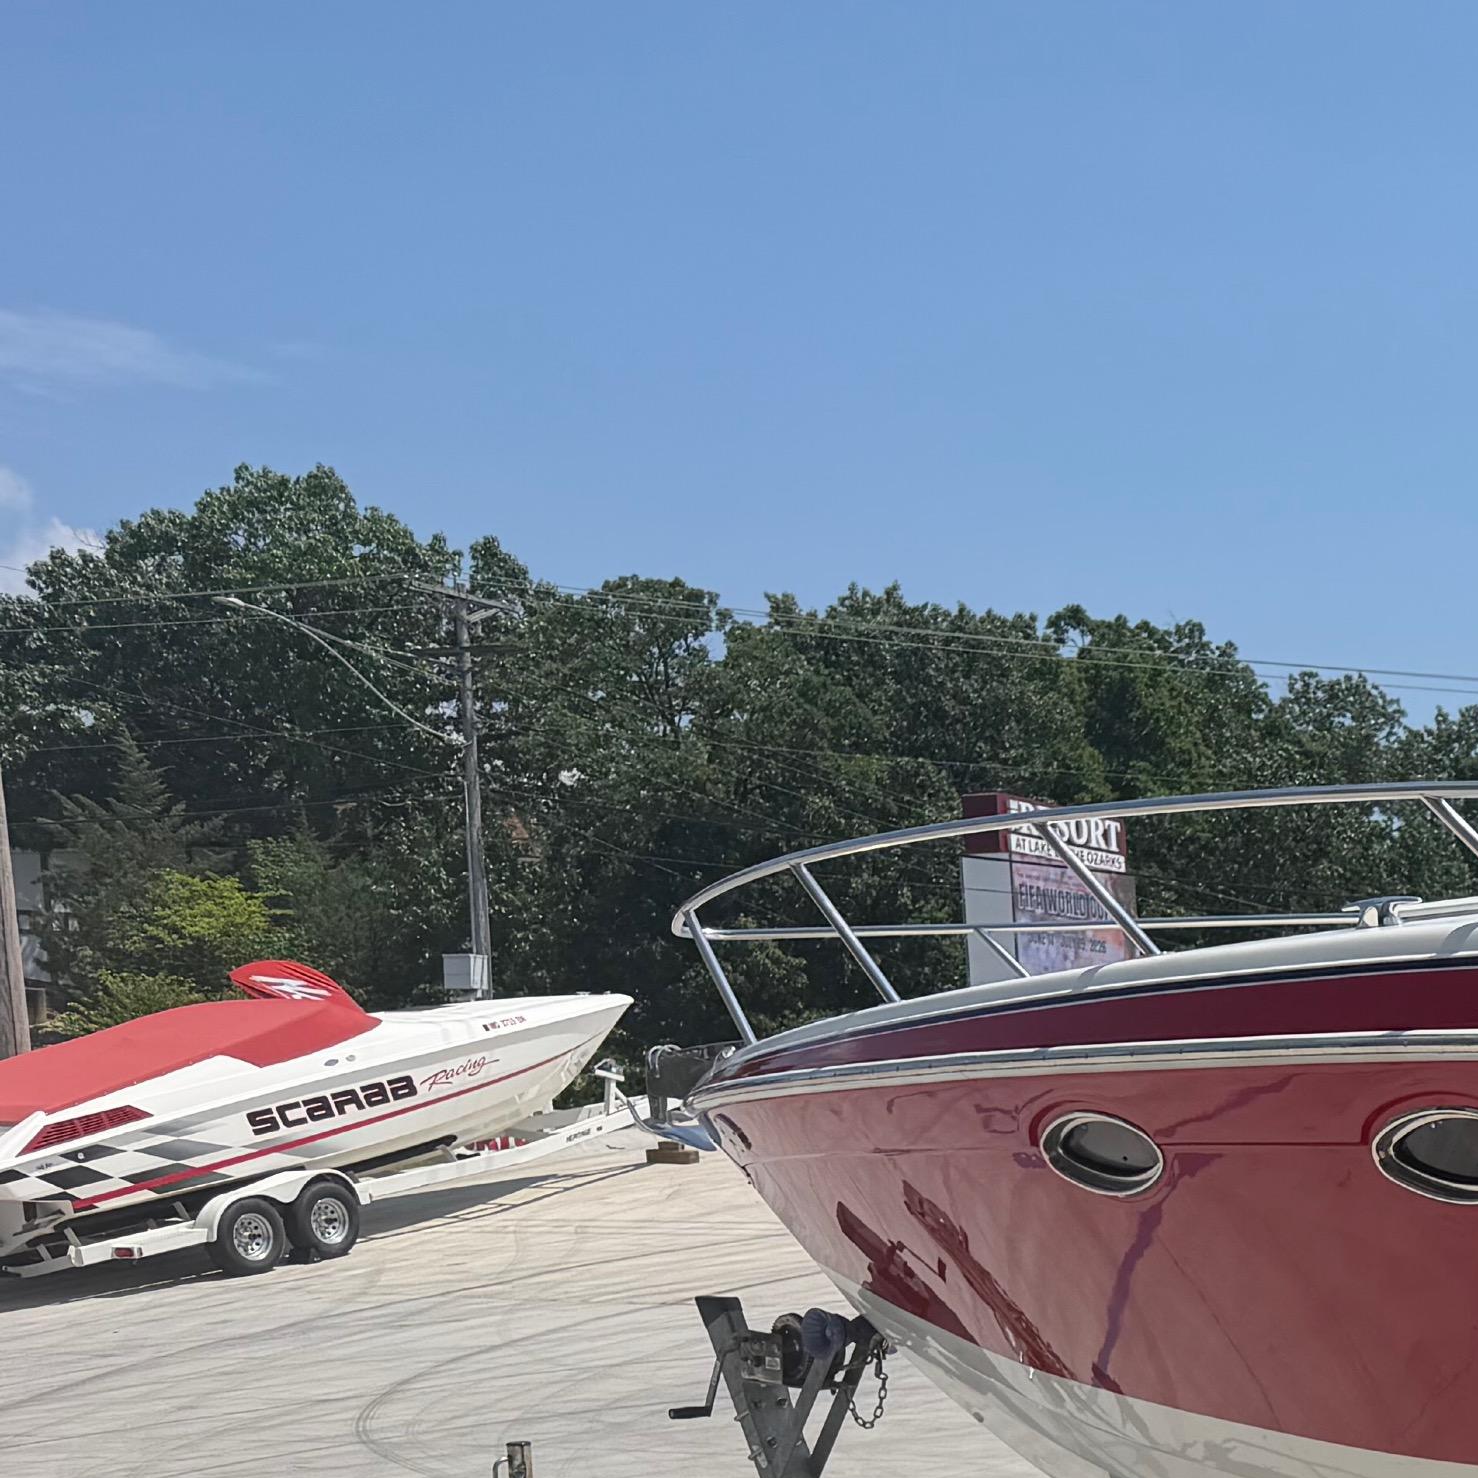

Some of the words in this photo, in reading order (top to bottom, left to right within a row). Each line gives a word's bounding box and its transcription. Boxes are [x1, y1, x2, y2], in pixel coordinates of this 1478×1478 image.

[1015, 838, 1026, 851] AT
[1087, 852, 1121, 869] OZARKS
[1046, 888, 1088, 918] WORLD
[247, 1075, 418, 1135] SCARAB
[420, 1056, 499, 1092] Racing
